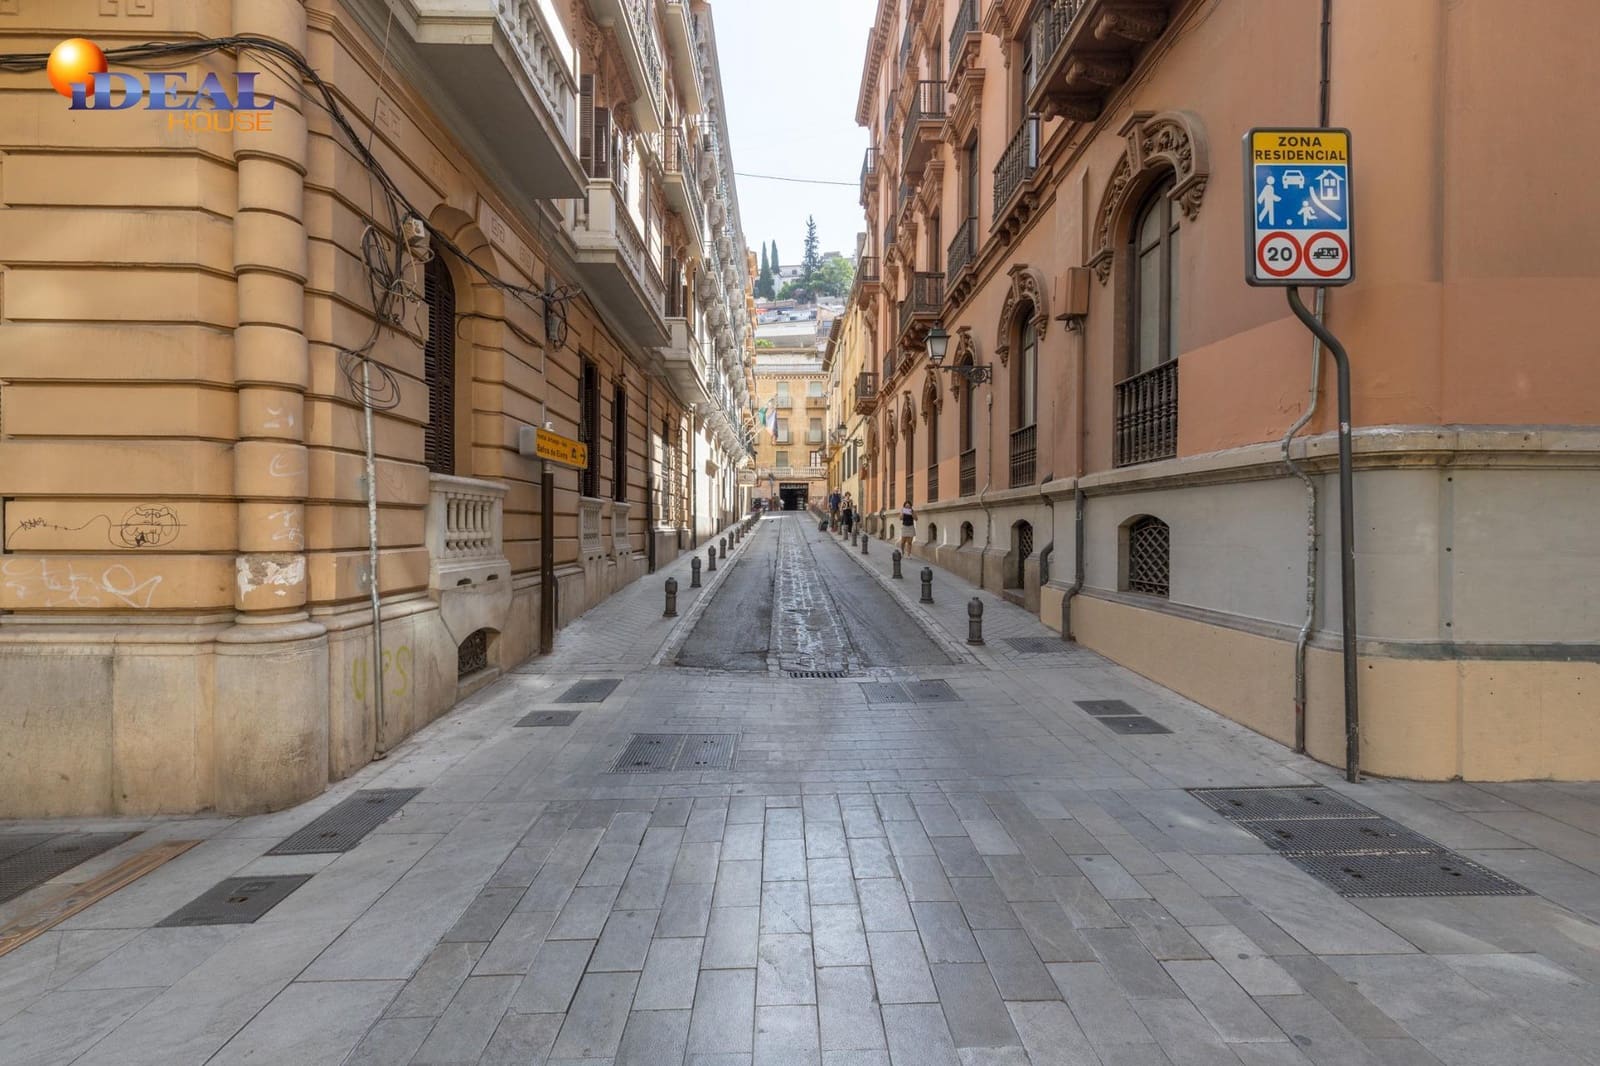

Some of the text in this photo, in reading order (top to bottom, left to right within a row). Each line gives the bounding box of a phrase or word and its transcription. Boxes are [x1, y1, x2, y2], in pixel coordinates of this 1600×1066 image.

[1278, 136, 1322, 147] ZONA
[1255, 150, 1346, 160] RESIDENCIAL
[1267, 246, 1293, 262] 20
